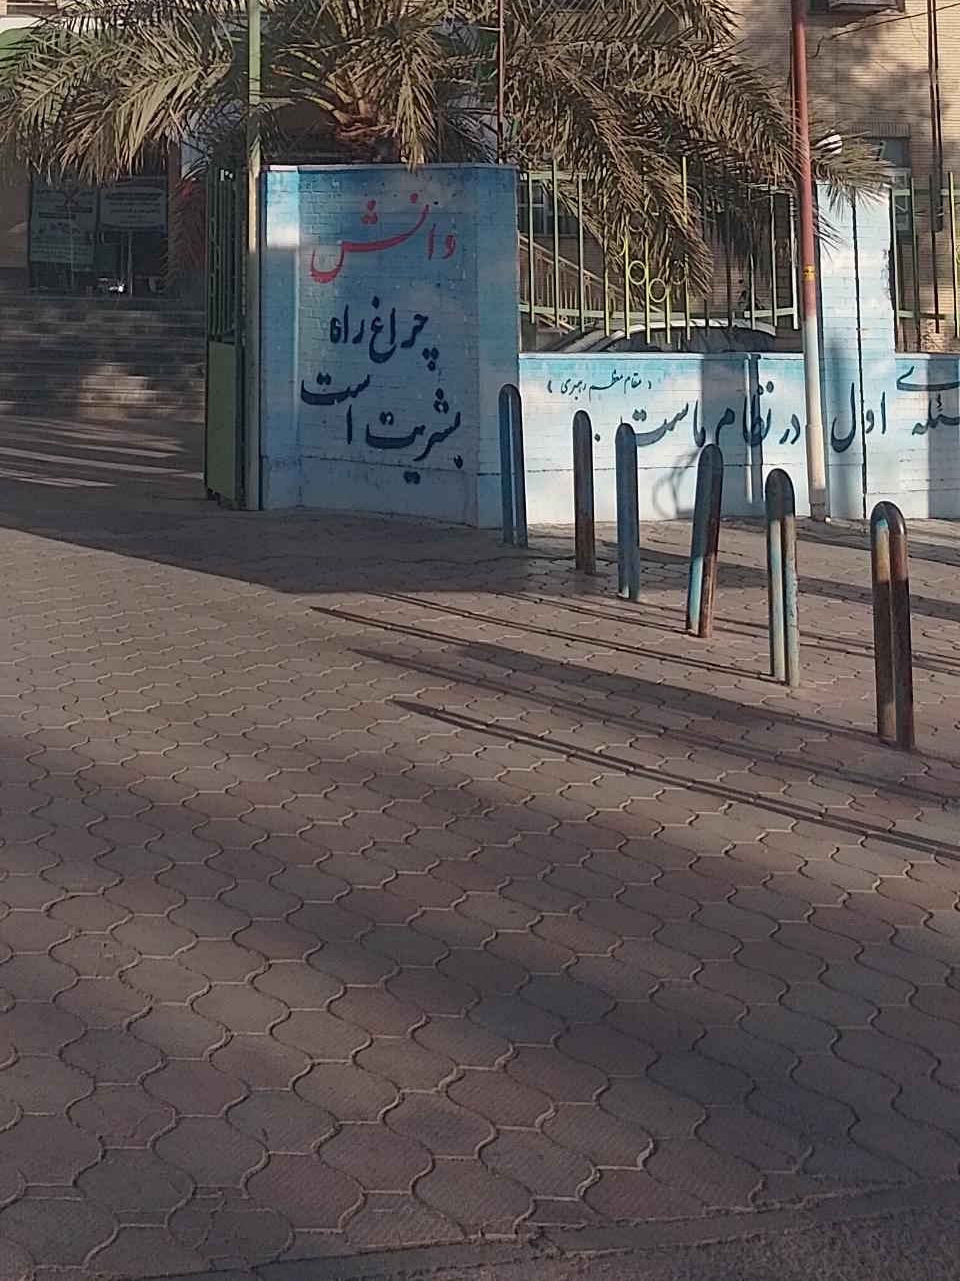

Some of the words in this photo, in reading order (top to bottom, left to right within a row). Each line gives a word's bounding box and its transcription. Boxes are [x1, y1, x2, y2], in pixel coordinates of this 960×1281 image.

[330, 304, 365, 344] راه
[368, 295, 439, 371] چراغ
[300, 372, 372, 445] است
[589, 369, 624, 402] معظم
[830, 381, 887, 453] اول
[365, 387, 464, 484] بشریت
[778, 413, 801, 445] در
